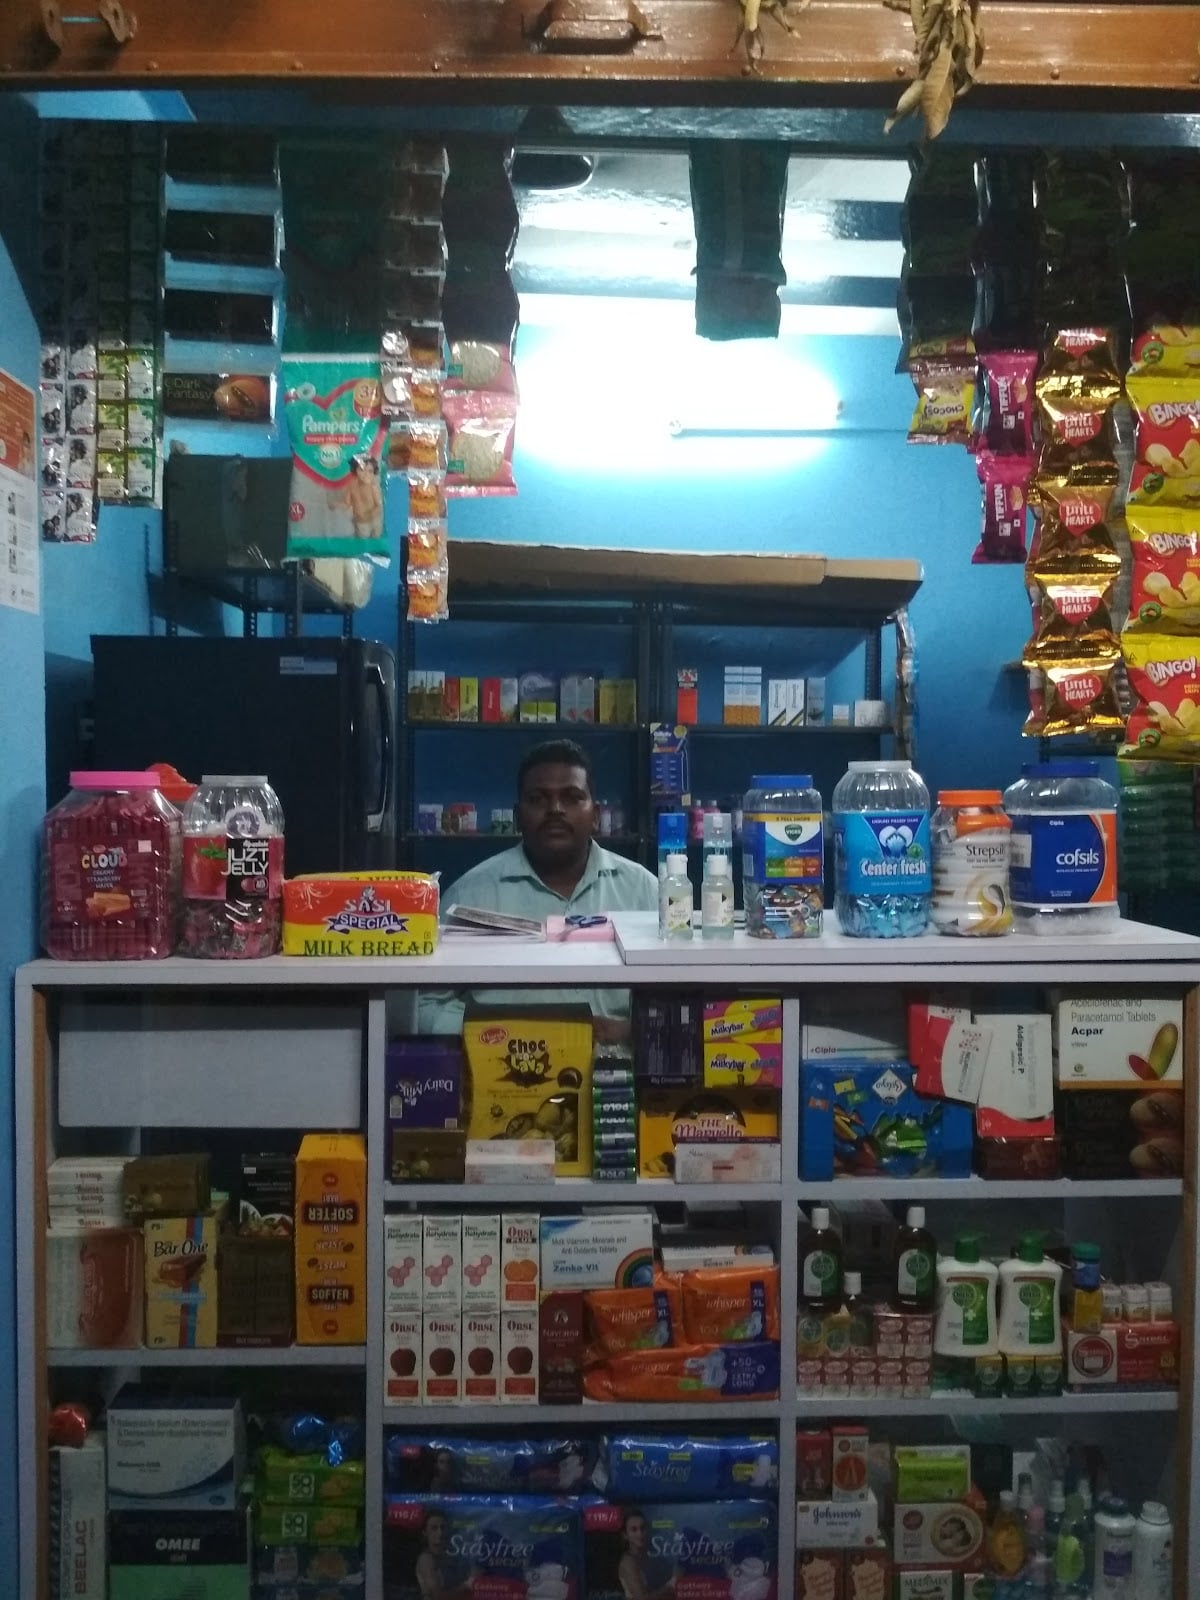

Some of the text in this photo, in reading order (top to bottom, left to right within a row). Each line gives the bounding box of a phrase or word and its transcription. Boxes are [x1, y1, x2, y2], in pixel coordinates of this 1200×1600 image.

[166, 388, 214, 401] Fantasy
[302, 414, 360, 434] Pampers
[1064, 413, 1094, 428] LITTLE
[1064, 424, 1095, 438] HEARTS
[994, 482, 1004, 522] TIFFUN
[290, 504, 303, 515] XL
[1065, 504, 1094, 517] LITTLE
[1065, 513, 1096, 527] HEARTS
[1061, 602, 1093, 616] HEARTS
[1146, 656, 1198, 684] BINGO!
[1064, 678, 1094, 691] LITTLE
[1064, 687, 1096, 701] HEARTS
[81, 853, 128, 869] CLOUD
[226, 848, 269, 861] JUZT
[1055, 848, 1100, 867] cofsils
[221, 861, 269, 876] JELLY
[861, 858, 927, 876] Center fresh
[344, 899, 391, 913] SASI
[339, 913, 398, 930] SPECIAL
[303, 939, 434, 956] MILK BREAD
[1071, 1011, 1157, 1022] Paracetamol Tablets
[711, 1022, 745, 1037] Milkybar
[1071, 1026, 1105, 1037] Acpar
[507, 1038, 547, 1054] Choc
[814, 1046, 837, 1054] Cipla
[510, 1055, 545, 1075] Lava
[710, 1059, 746, 1071] Milkybar
[398, 1077, 454, 1098] Dairy Milk
[602, 1103, 629, 1111] POLO
[699, 1118, 723, 1128] THE
[599, 1170, 626, 1178] POLO
[307, 1206, 354, 1221] SOFTER
[507, 1227, 535, 1238] ORSL
[153, 1239, 208, 1257] Bar One
[585, 1262, 599, 1272] Vit
[311, 1288, 350, 1300] SOFTER
[705, 1296, 747, 1310] whisper
[753, 1299, 765, 1307] XL
[610, 1307, 653, 1323] whisper
[657, 1310, 670, 1318] XL
[390, 1321, 417, 1333] ORSL
[429, 1321, 457, 1333] ORSL
[468, 1320, 495, 1332] ORSL
[507, 1319, 534, 1332] ORSL
[631, 1461, 692, 1481] Stayfree
[155, 1538, 201, 1551] OMEE
[445, 1534, 535, 1564] Stayfree
[646, 1534, 735, 1561] Stayfree
[74, 1519, 88, 1595] BEELAC
